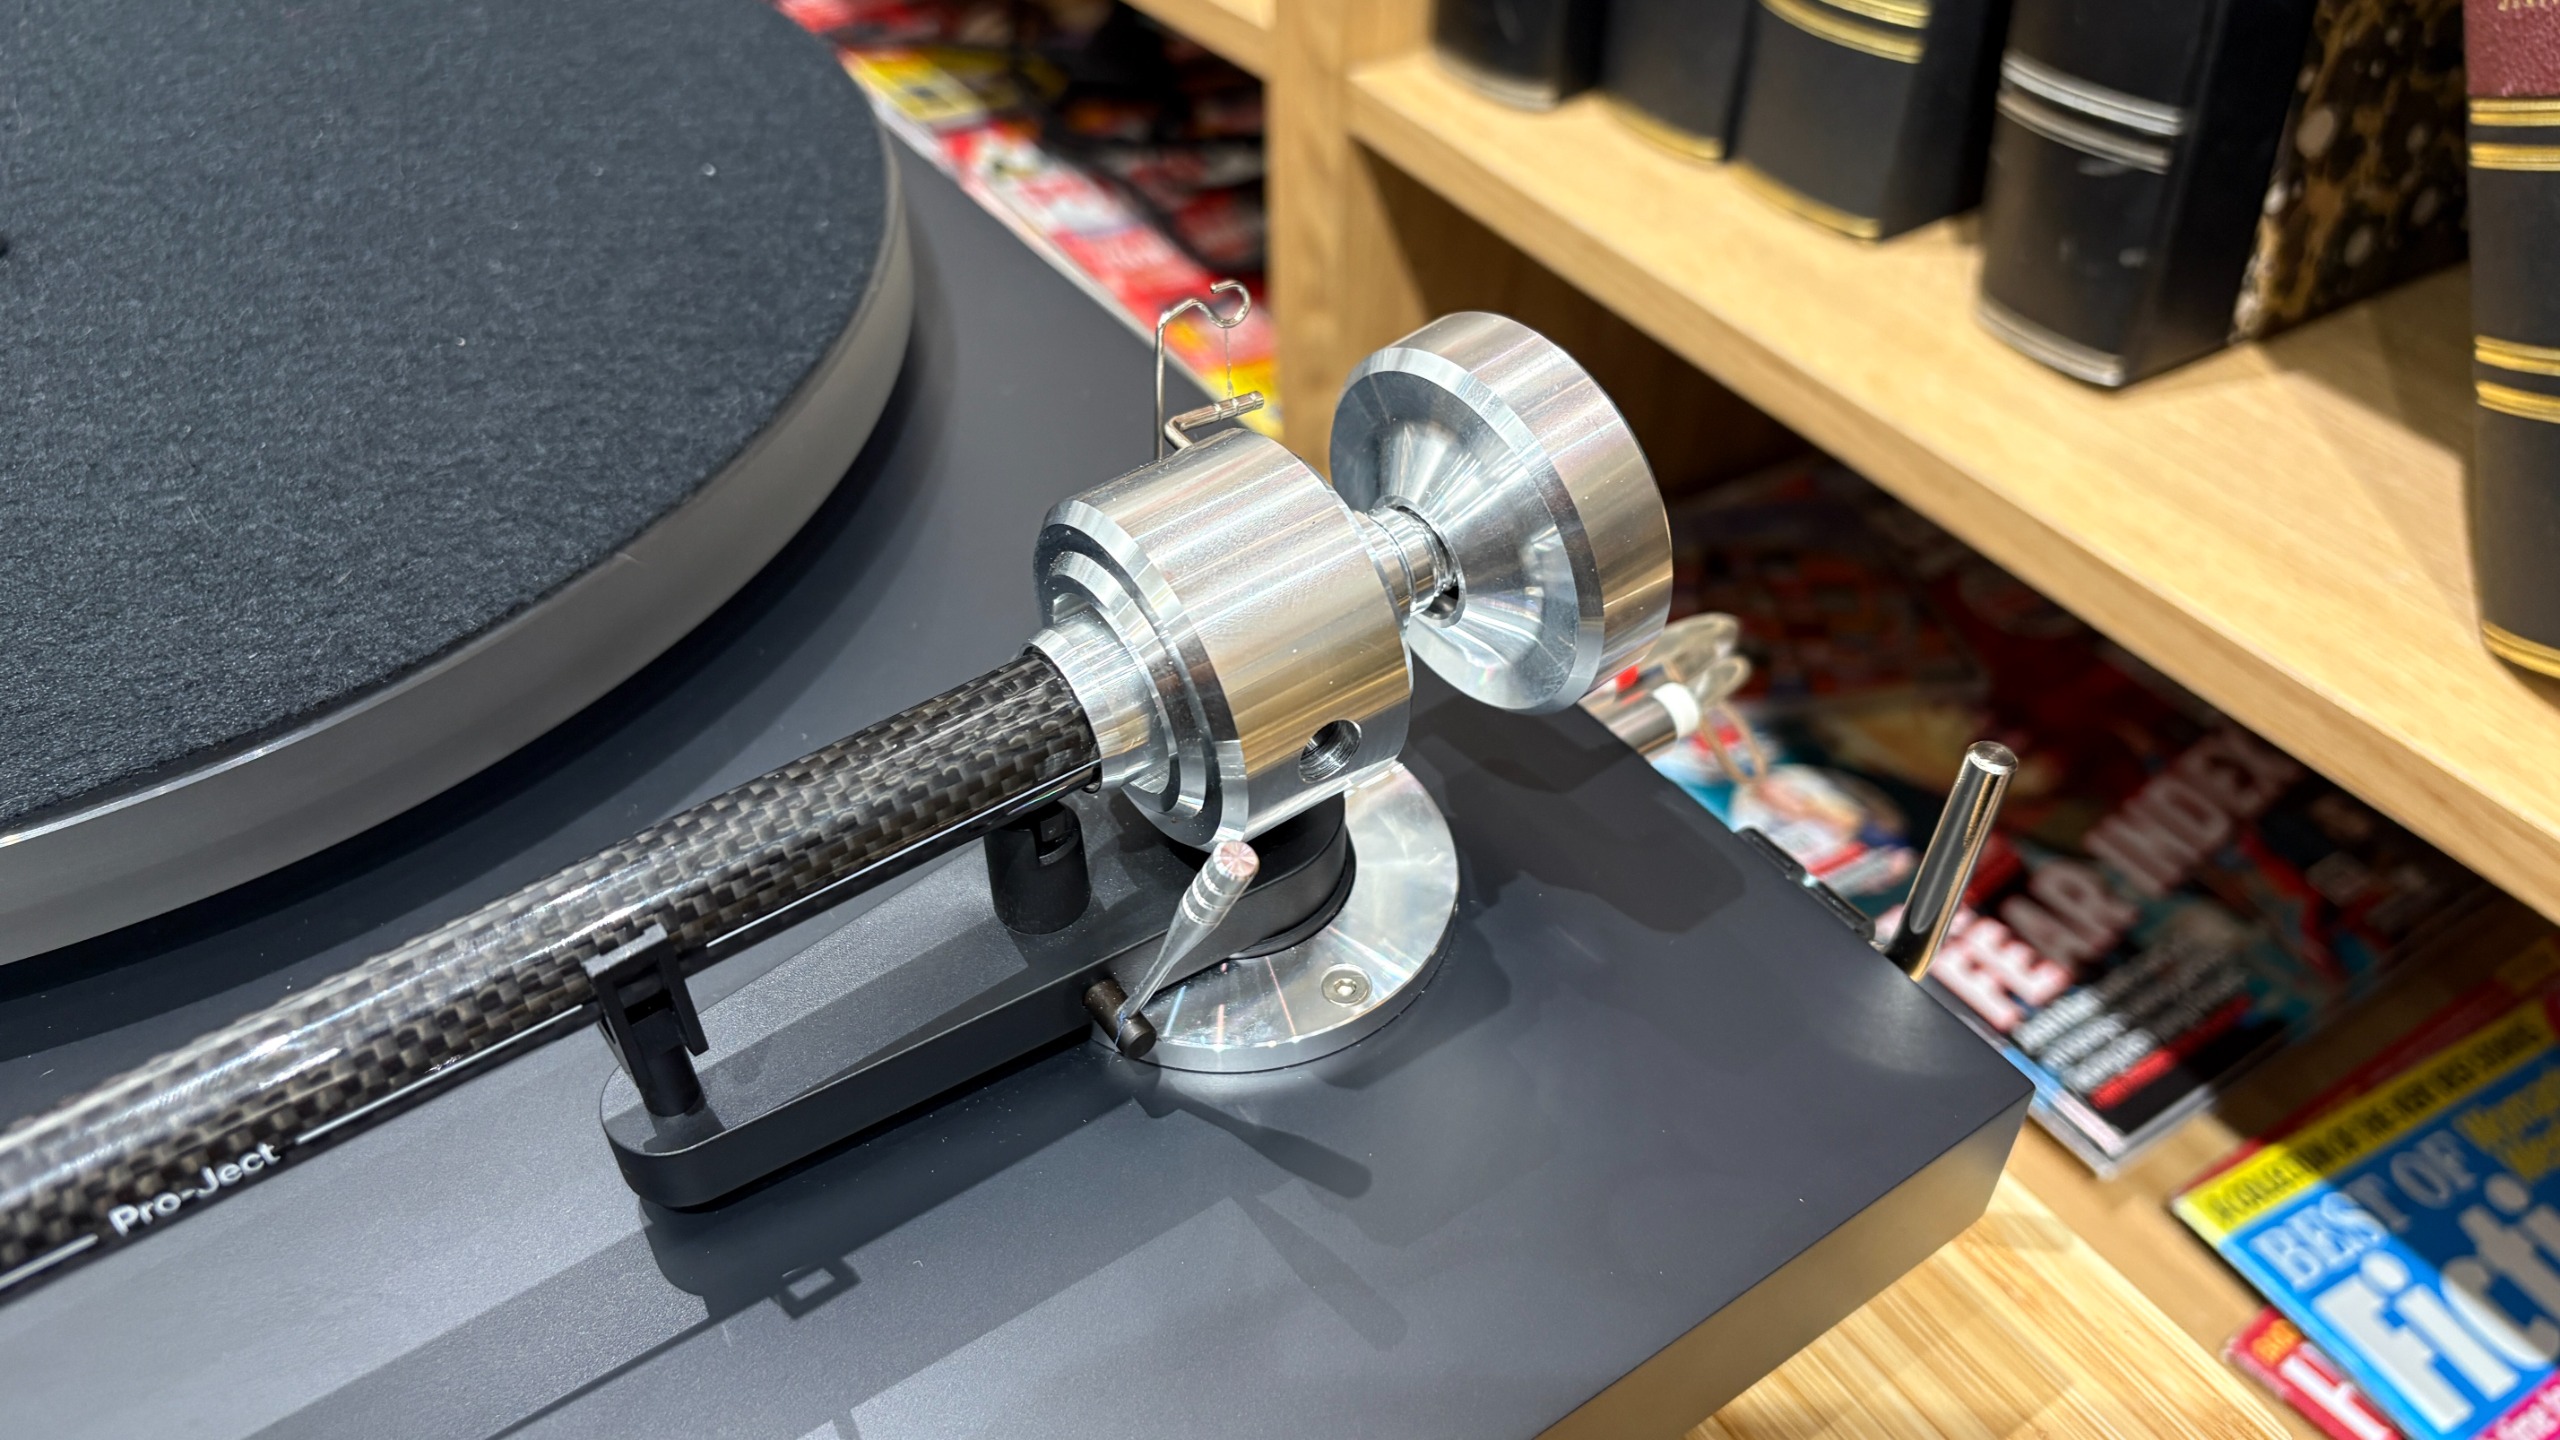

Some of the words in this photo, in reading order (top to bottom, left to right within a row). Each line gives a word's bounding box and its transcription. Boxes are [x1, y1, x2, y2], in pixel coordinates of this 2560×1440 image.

[1935, 861, 2137, 1029] FEAR
[2085, 730, 2308, 892] INDEX
[108, 1142, 281, 1236] Pro-Ject
[2250, 1174, 2410, 1291] BEST
[2390, 1131, 2476, 1208] OF
